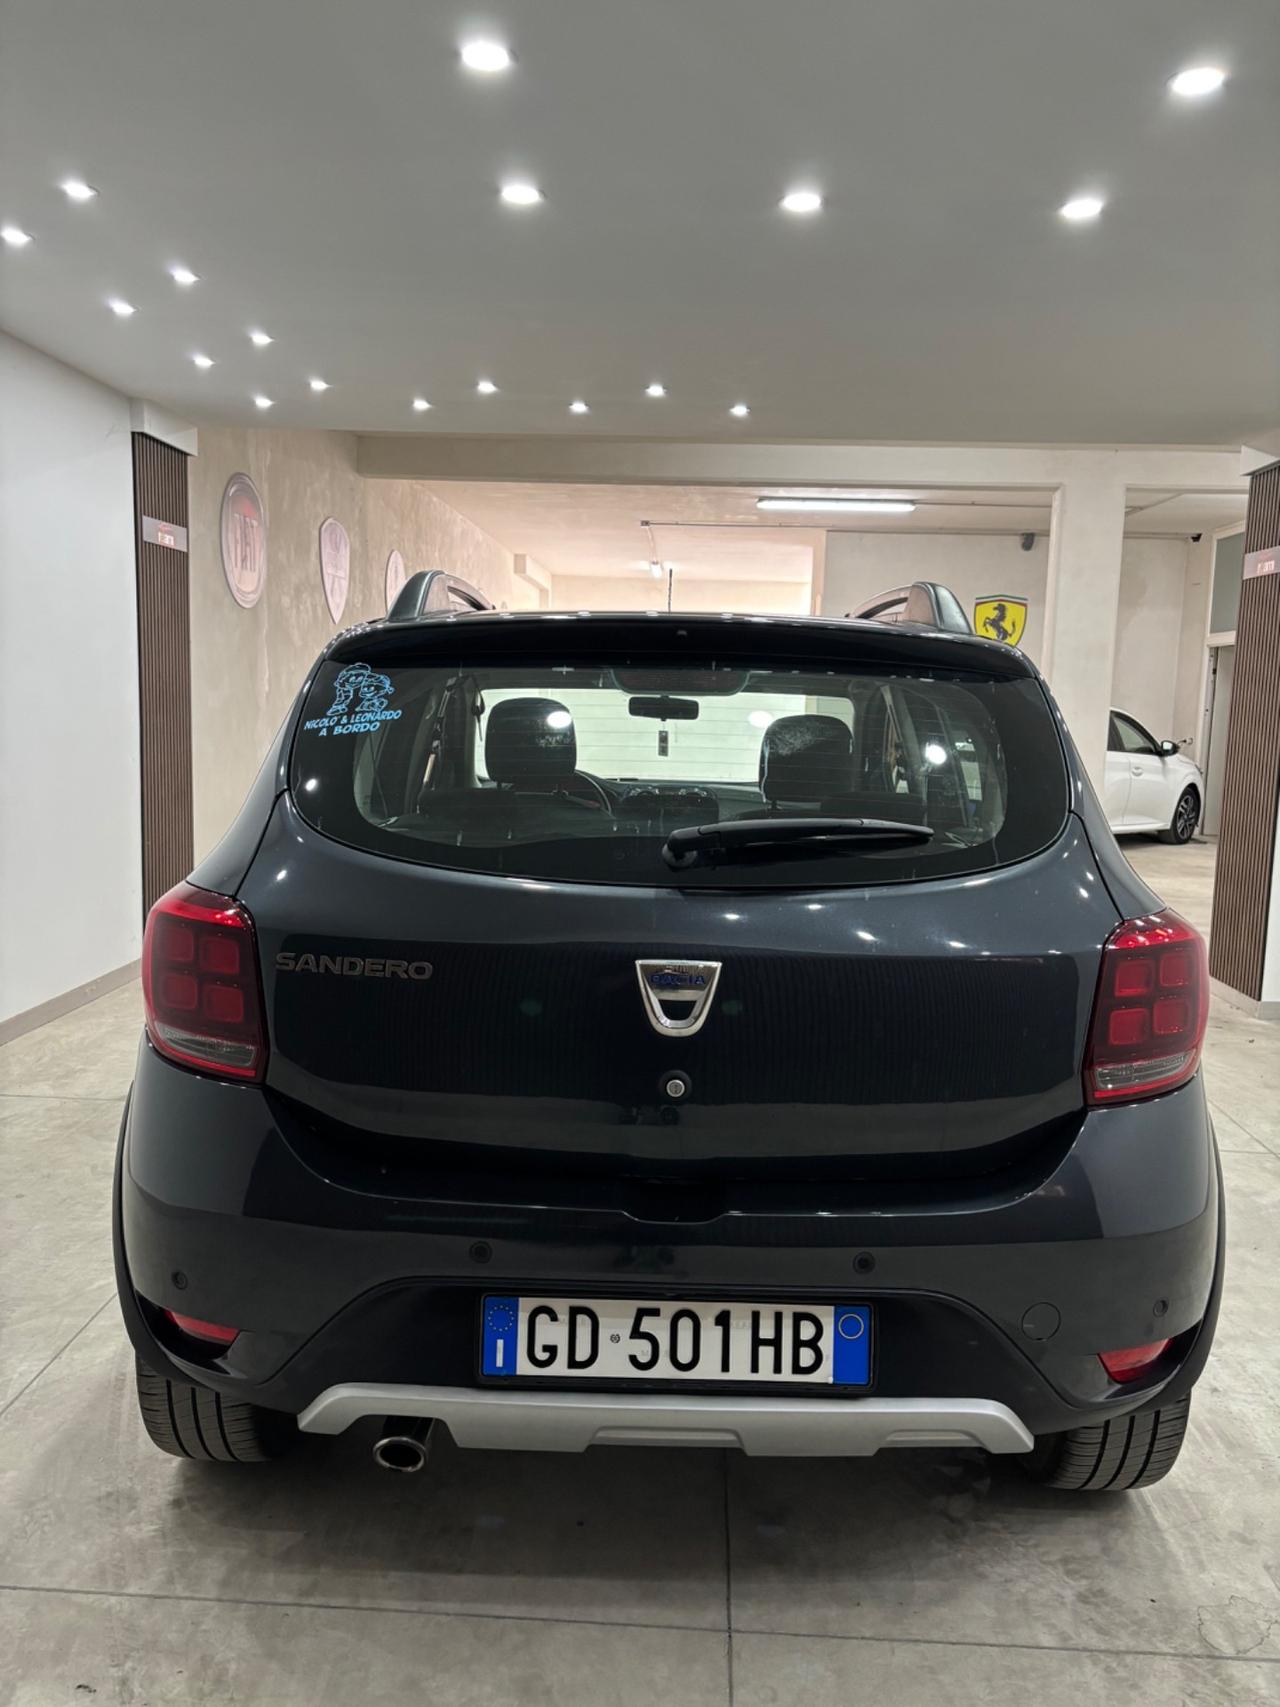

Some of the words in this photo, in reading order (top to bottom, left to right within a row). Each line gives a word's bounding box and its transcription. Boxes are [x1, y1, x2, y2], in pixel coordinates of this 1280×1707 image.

[341, 715, 348, 724] &
[350, 710, 402, 724] LEONARDO
[319, 728, 327, 736] A
[333, 723, 380, 735] BORDO
[275, 952, 433, 980] SANDERO
[527, 1305, 600, 1369] GD
